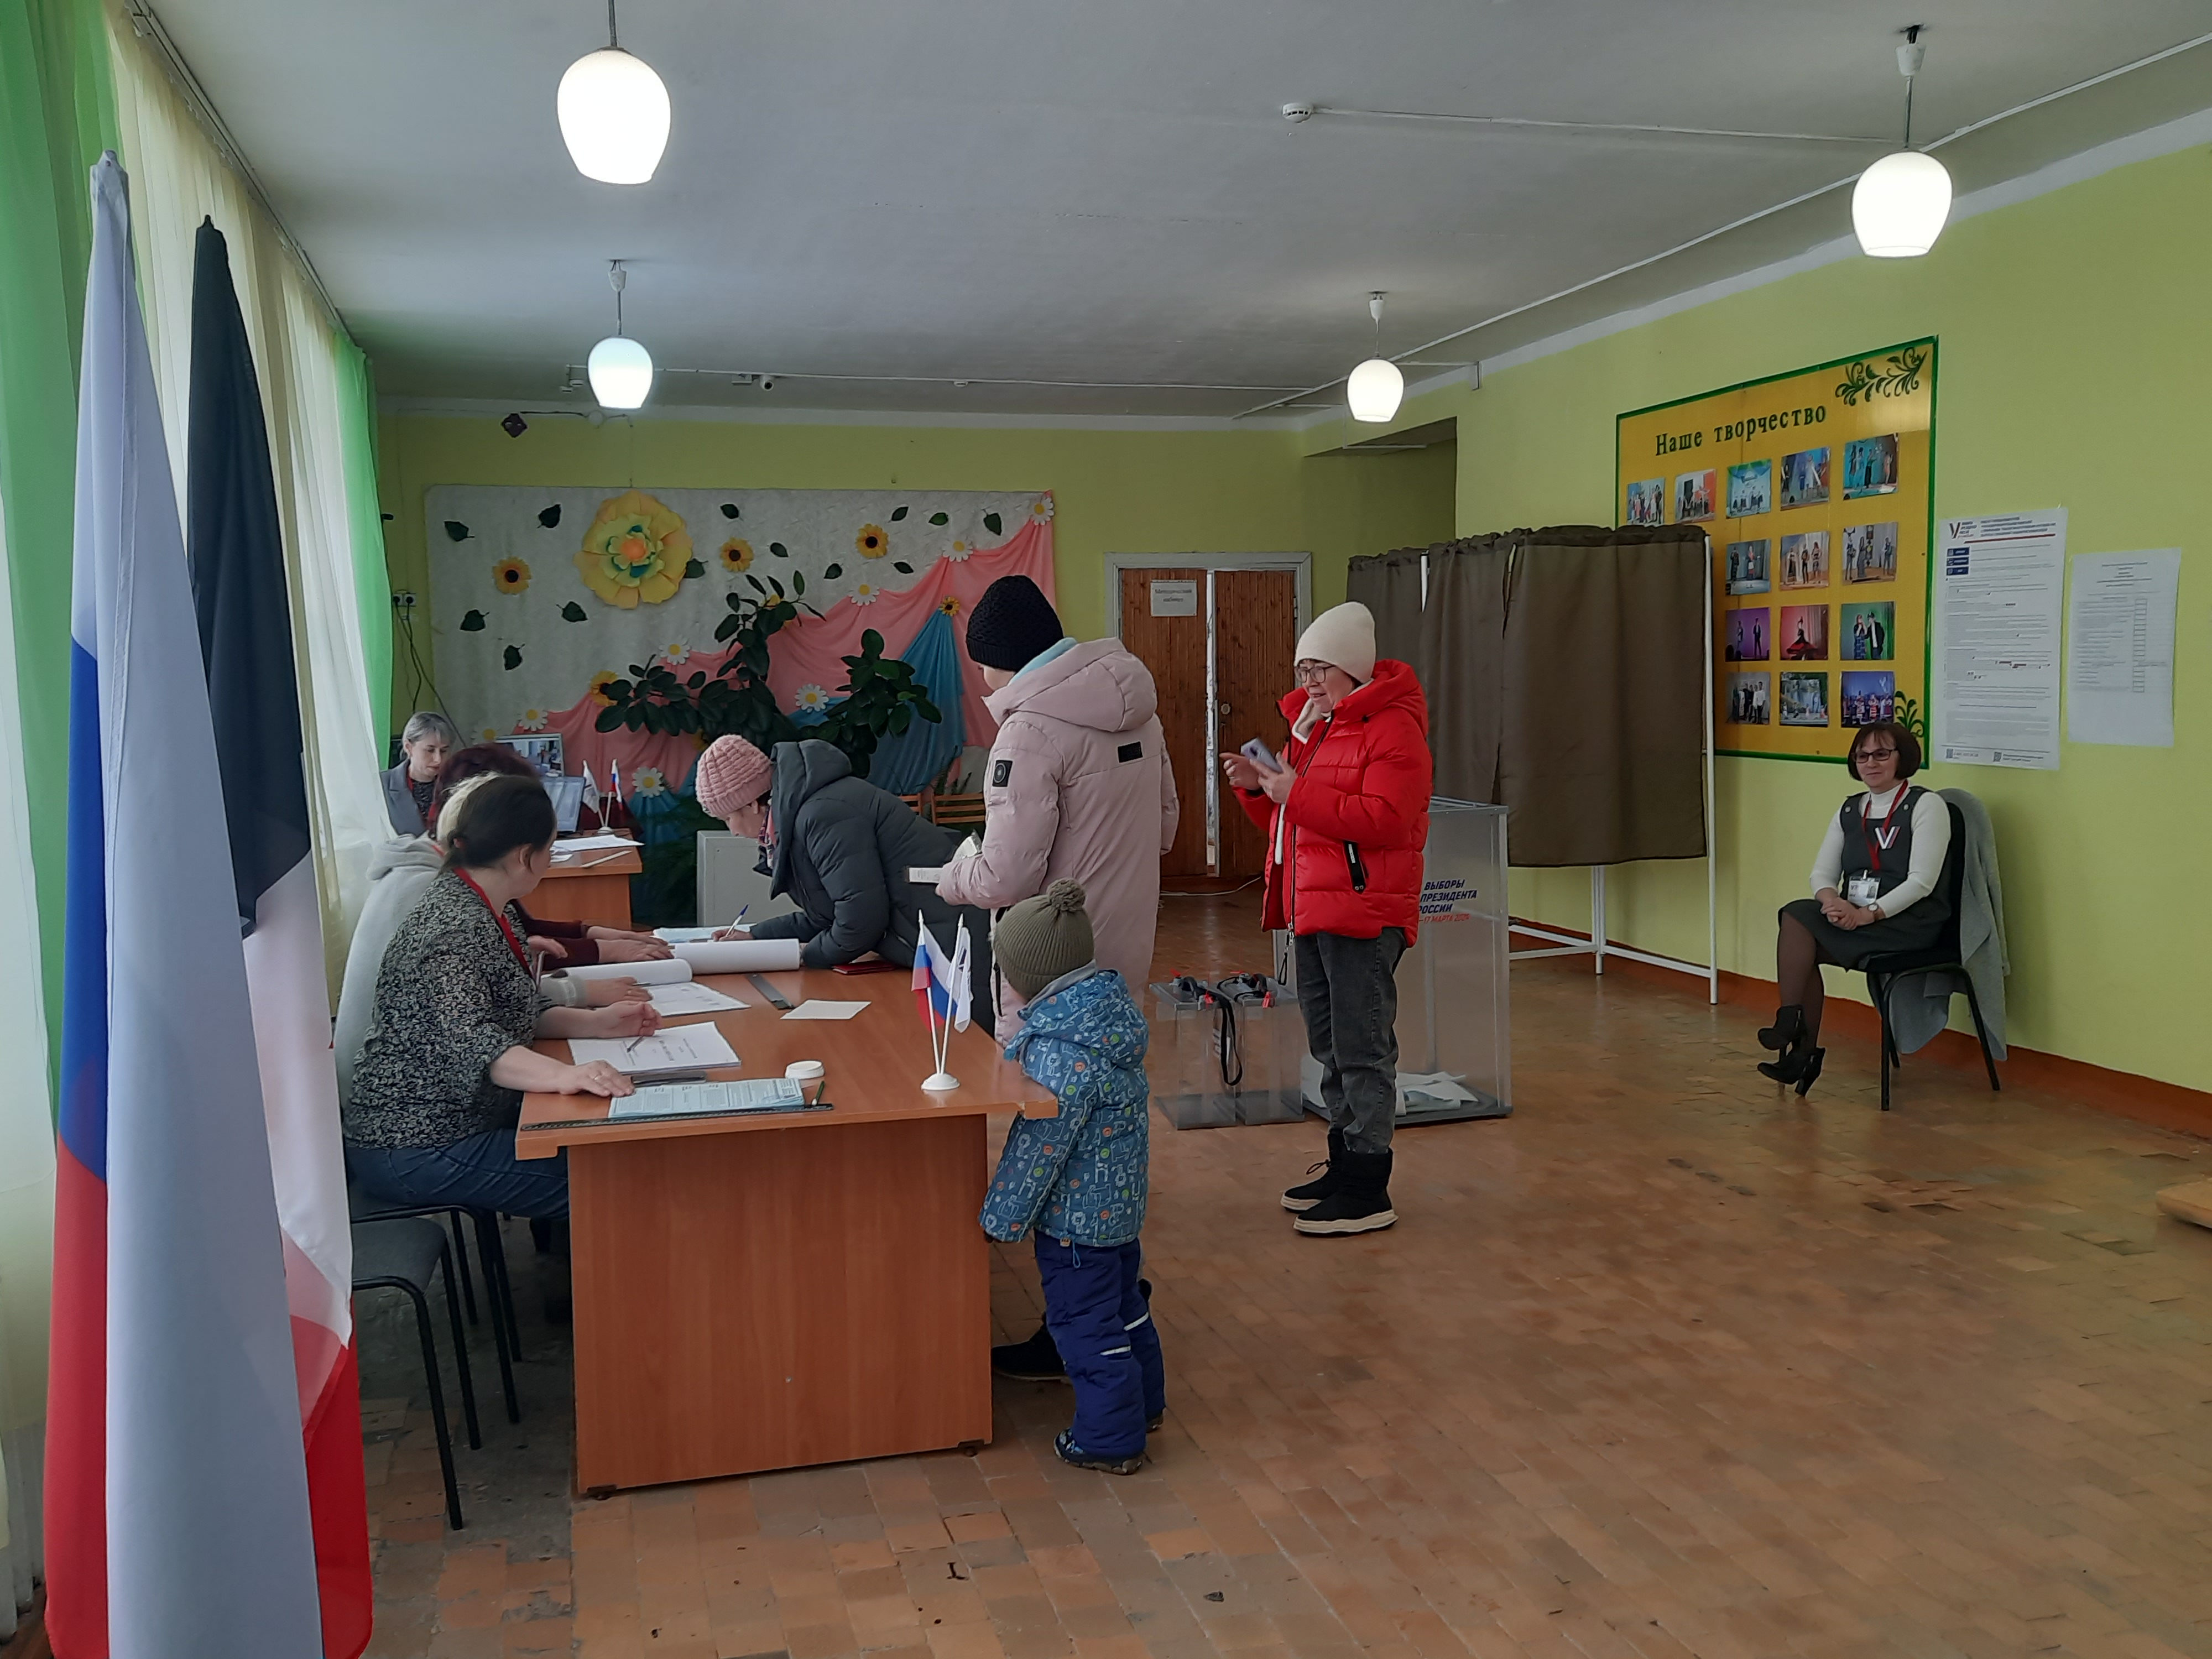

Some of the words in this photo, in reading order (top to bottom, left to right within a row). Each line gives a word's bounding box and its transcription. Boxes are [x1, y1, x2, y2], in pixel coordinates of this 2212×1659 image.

[1656, 431, 1703, 456] Наше
[1714, 405, 1826, 442] творчество
[1424, 879, 1465, 890] ВЫБОРЫ
[1420, 890, 1478, 902] ПРЕЗИДЕНТА
